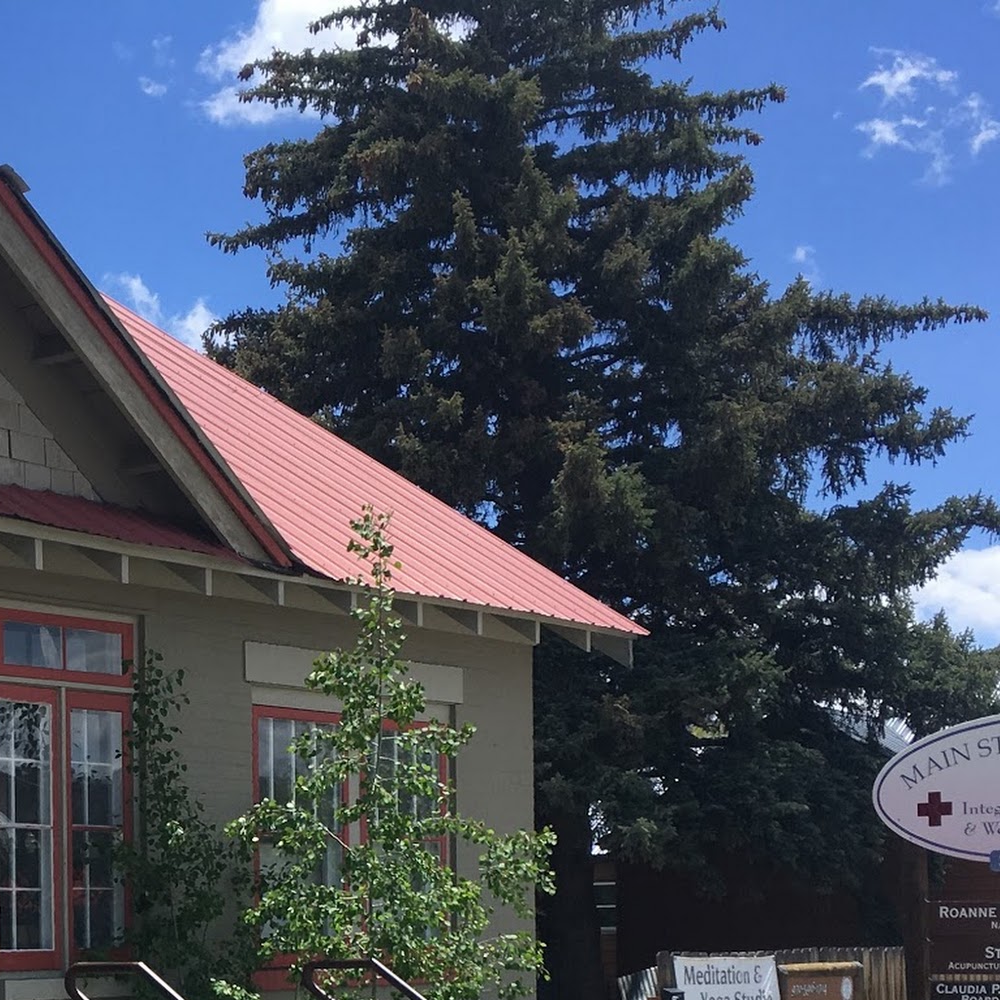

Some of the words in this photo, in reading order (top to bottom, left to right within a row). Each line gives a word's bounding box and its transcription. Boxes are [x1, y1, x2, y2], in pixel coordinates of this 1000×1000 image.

[900, 743, 971, 790] MAIN
[963, 822, 976, 836] &
[939, 906, 997, 918] ROANNE
[683, 964, 751, 985] Meditation
[753, 965, 763, 984] &
[936, 983, 987, 994] CLAUDIA
